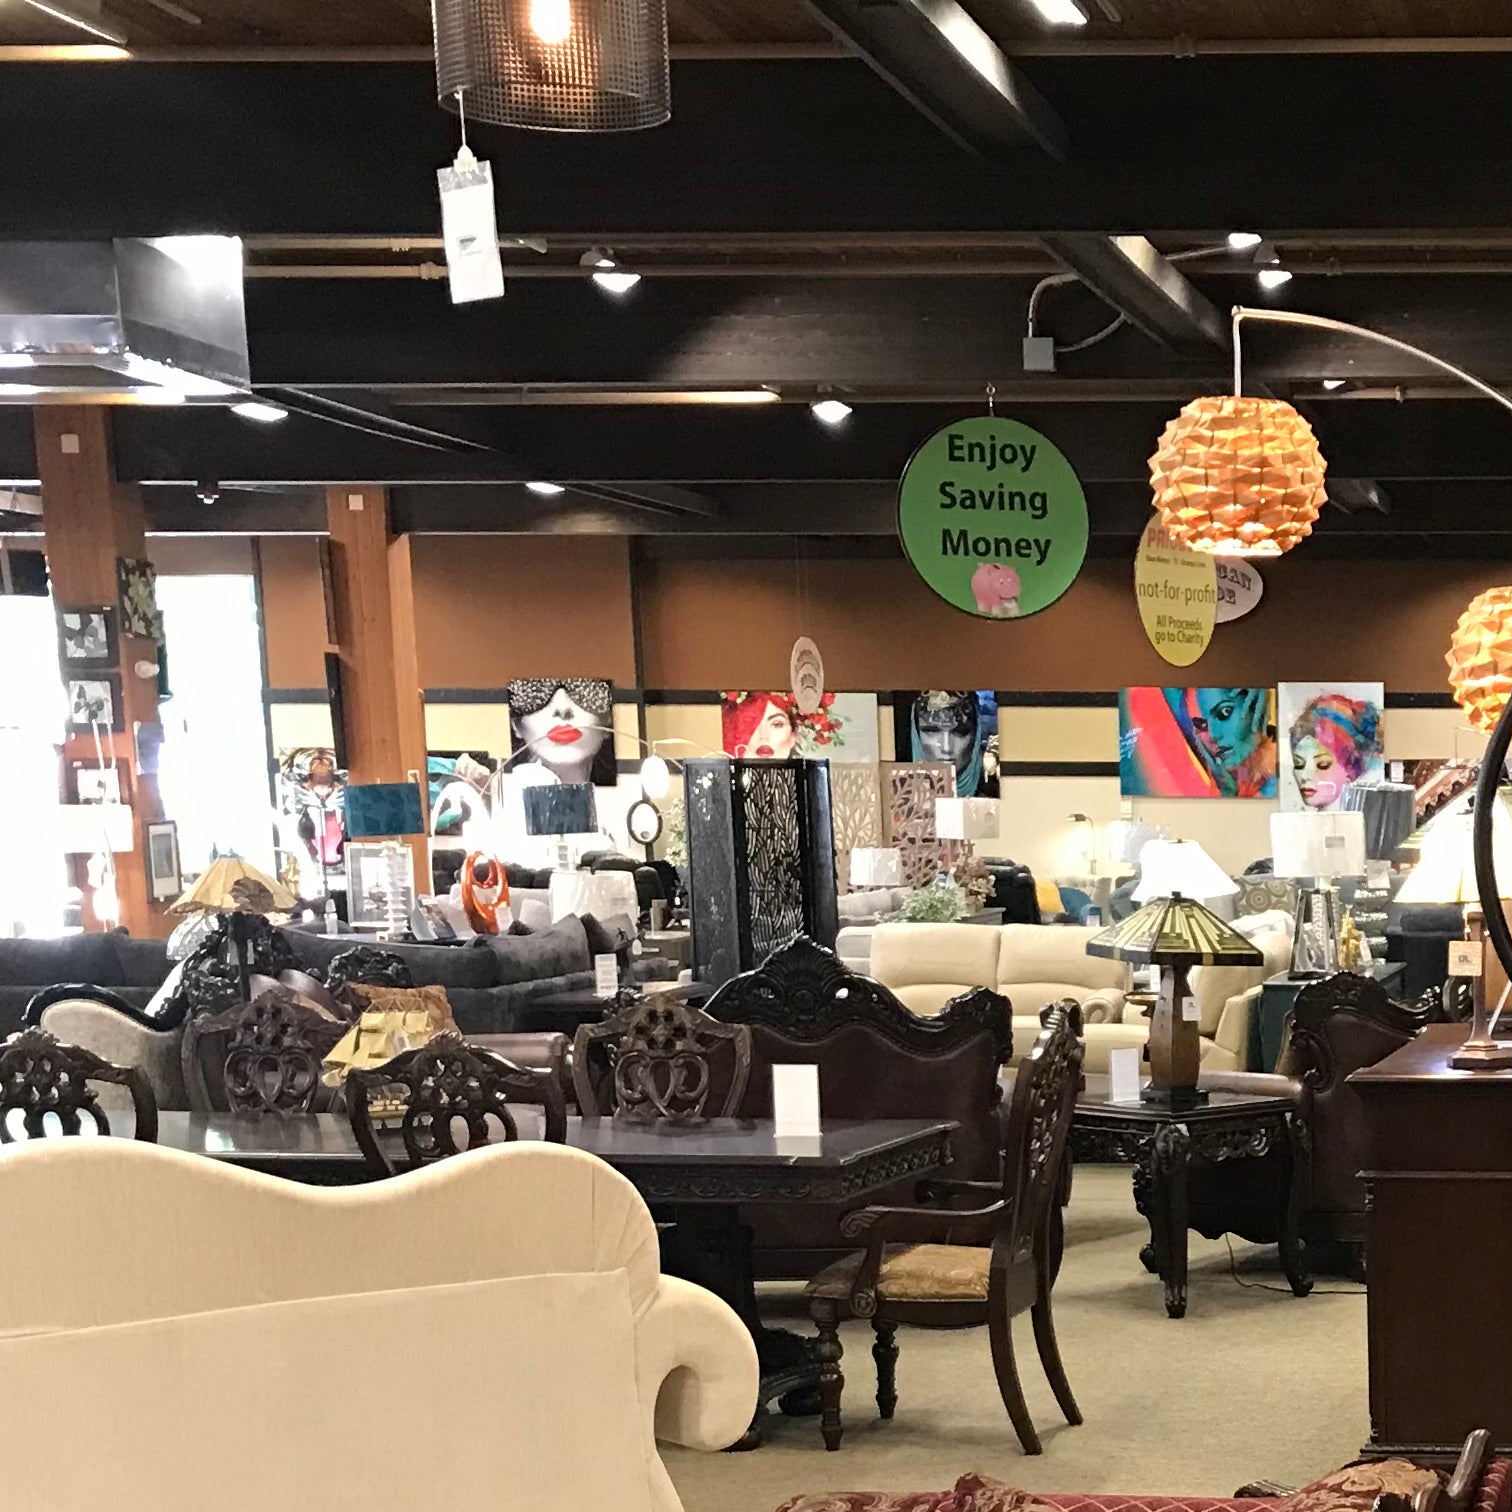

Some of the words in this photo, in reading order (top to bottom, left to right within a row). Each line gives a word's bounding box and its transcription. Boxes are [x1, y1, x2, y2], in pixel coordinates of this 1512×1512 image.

[948, 434, 1036, 472] Enjoy
[939, 481, 1048, 519] Saving
[941, 528, 1051, 566] Money
[1139, 579, 1216, 606] not-for-profit
[1155, 631, 1166, 644] go
[1167, 630, 1176, 642] to
[1177, 630, 1204, 648] Charity
[1156, 615, 1166, 628] All
[1168, 616, 1203, 631] Proceeds
